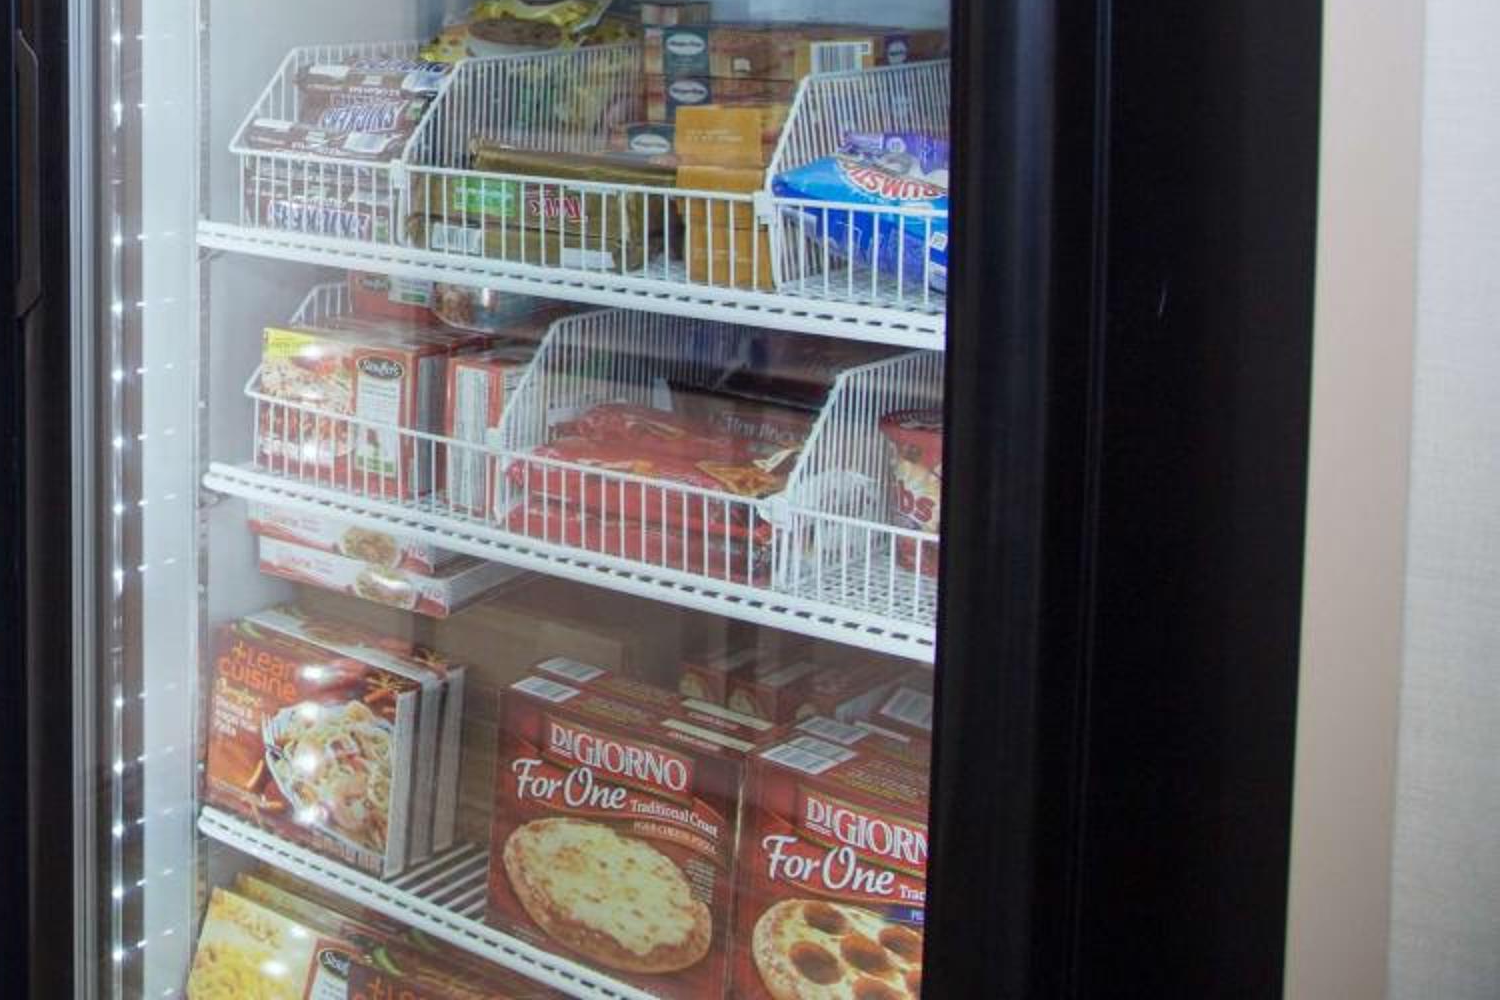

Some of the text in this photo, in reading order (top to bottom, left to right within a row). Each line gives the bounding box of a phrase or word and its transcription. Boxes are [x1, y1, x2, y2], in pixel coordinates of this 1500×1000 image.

[512, 758, 627, 810] For One
[806, 797, 928, 865] DIGIORN
[762, 835, 897, 894] For One
